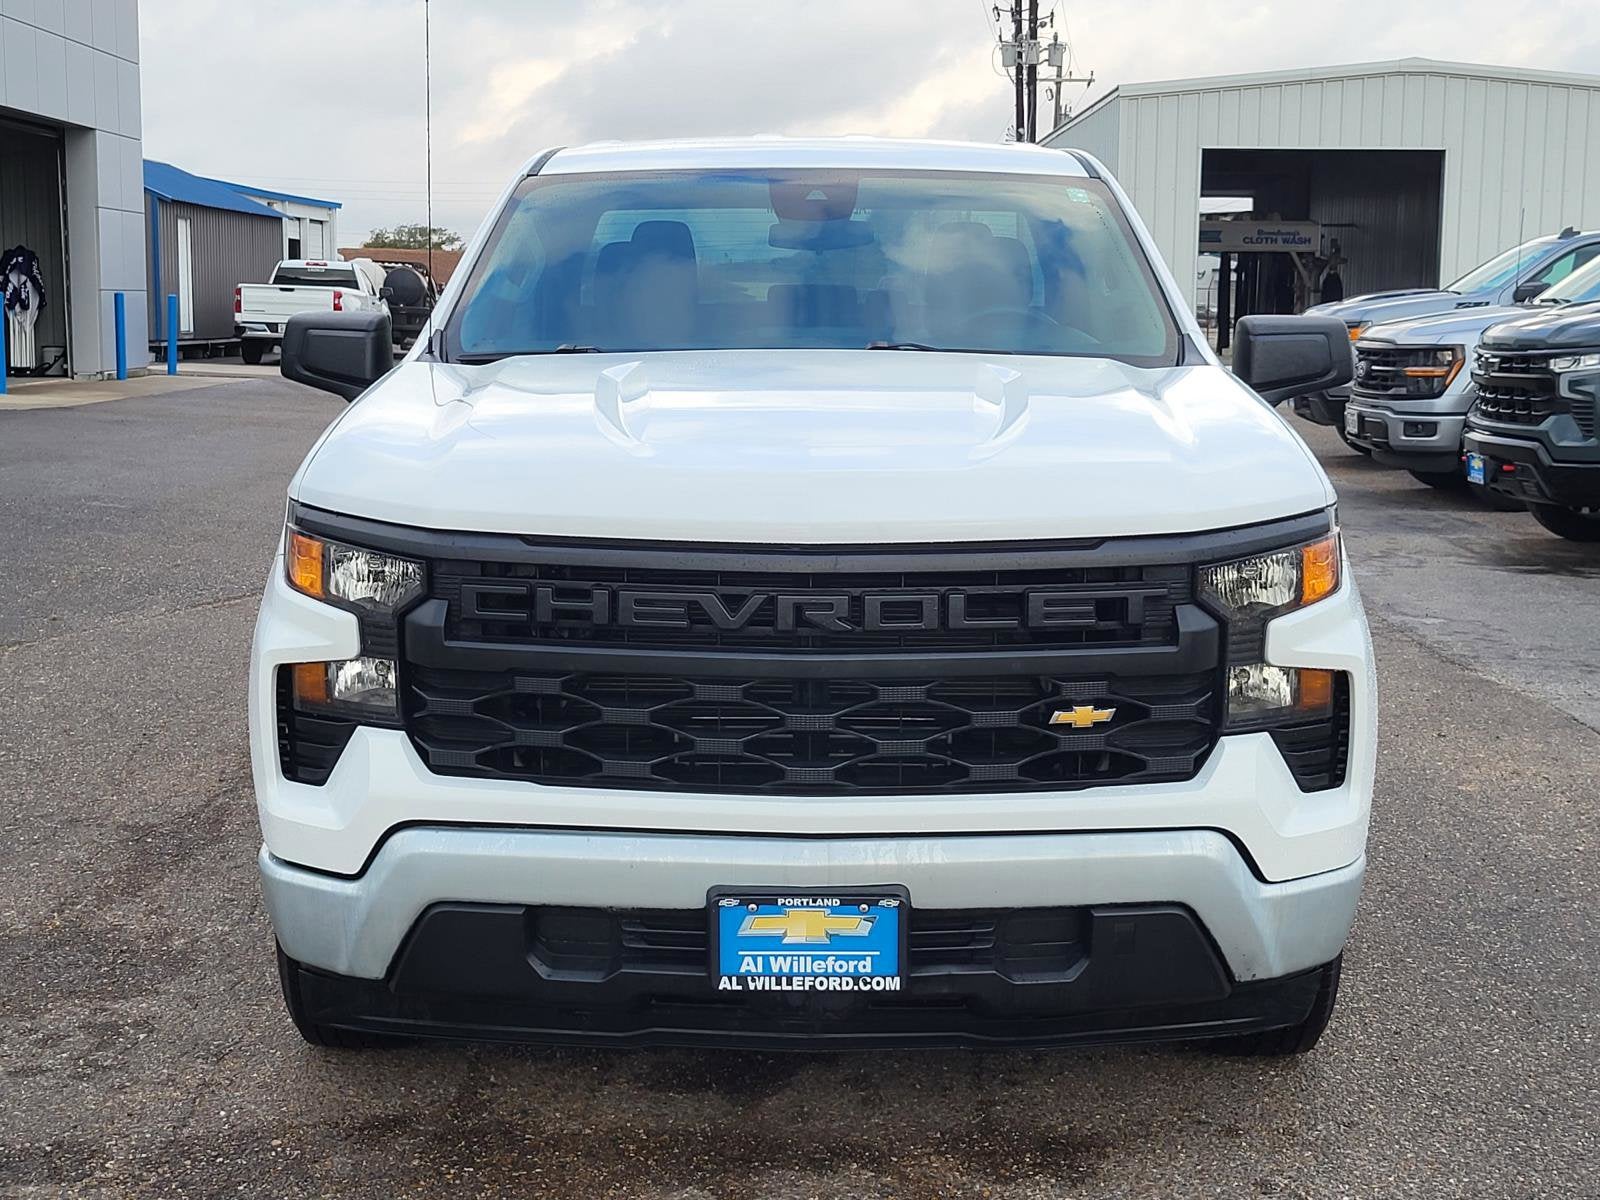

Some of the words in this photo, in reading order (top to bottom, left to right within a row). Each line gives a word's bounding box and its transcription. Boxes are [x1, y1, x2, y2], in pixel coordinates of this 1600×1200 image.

[1242, 236, 1278, 245] CLOTH
[1281, 236, 1312, 245] WASH
[459, 584, 1169, 631] CHEVROLET
[777, 898, 841, 907] PORTLAND
[739, 956, 763, 973] Al
[769, 956, 873, 973] Willeford
[718, 976, 743, 991] AL
[747, 976, 901, 991] WILLEFORD.COM
